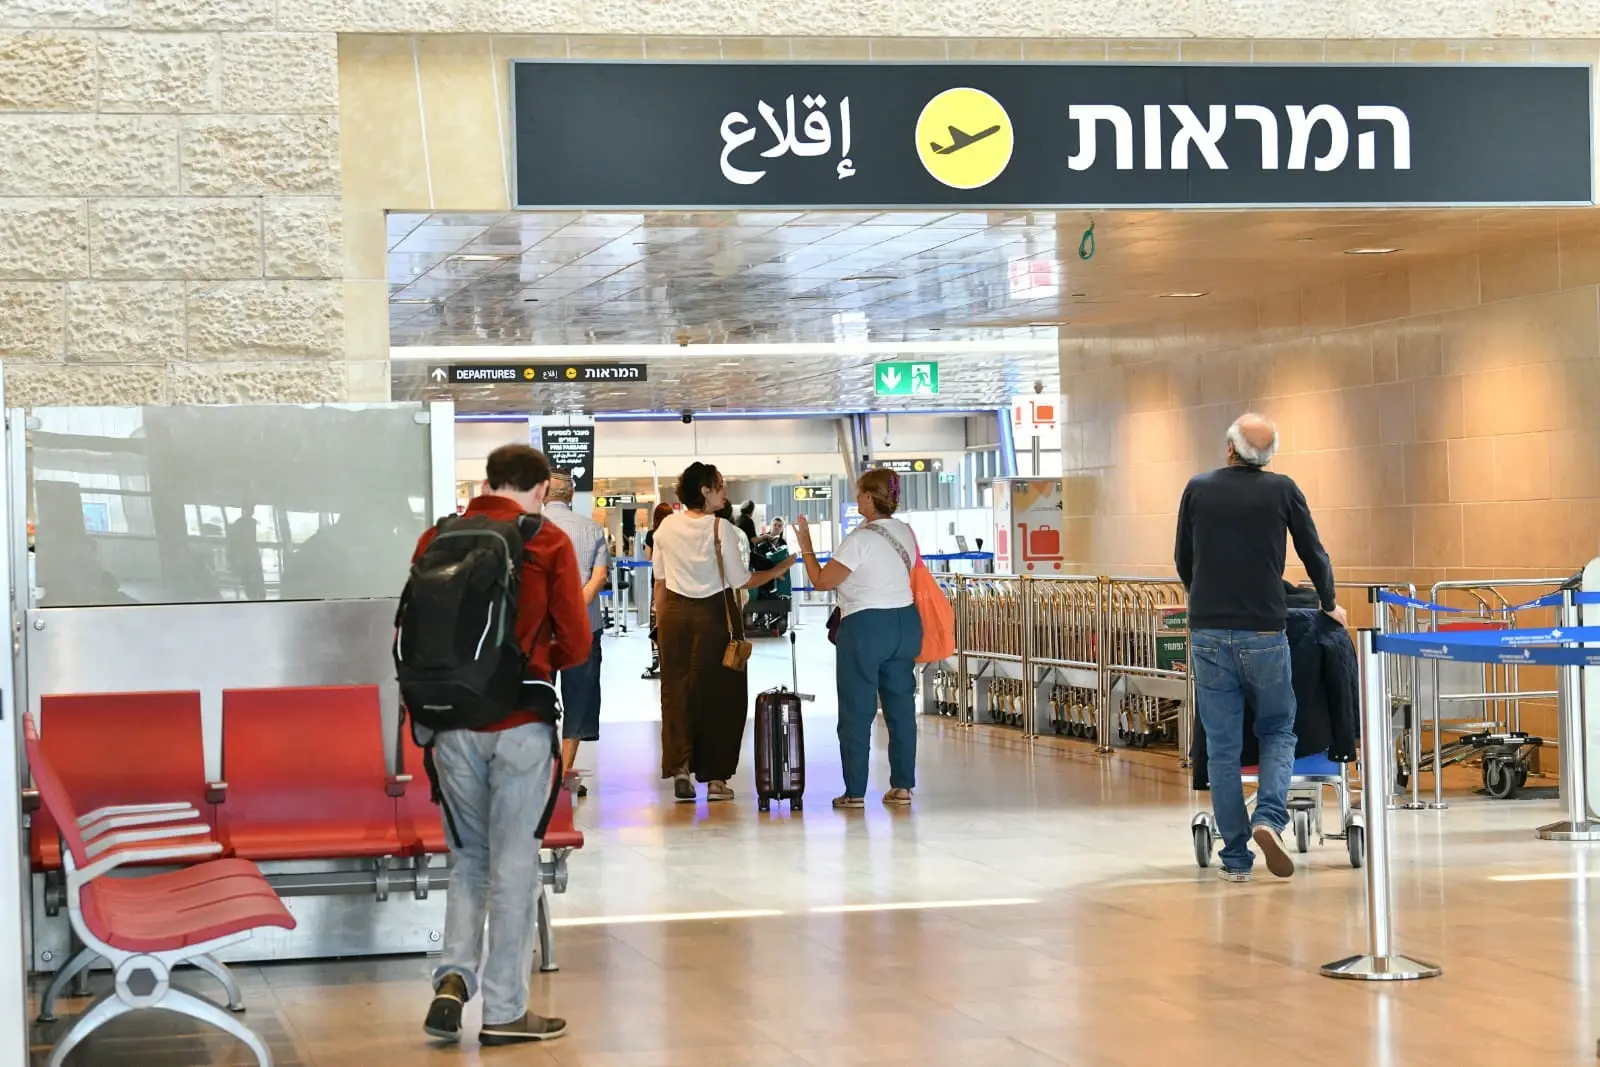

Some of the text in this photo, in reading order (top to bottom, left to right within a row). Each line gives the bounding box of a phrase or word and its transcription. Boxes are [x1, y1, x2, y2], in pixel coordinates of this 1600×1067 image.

[720, 95, 856, 184] إقلاع
[1067, 103, 1411, 171] המראות
[456, 369, 516, 380] DEPARTURES
[584, 367, 639, 379] המראות
